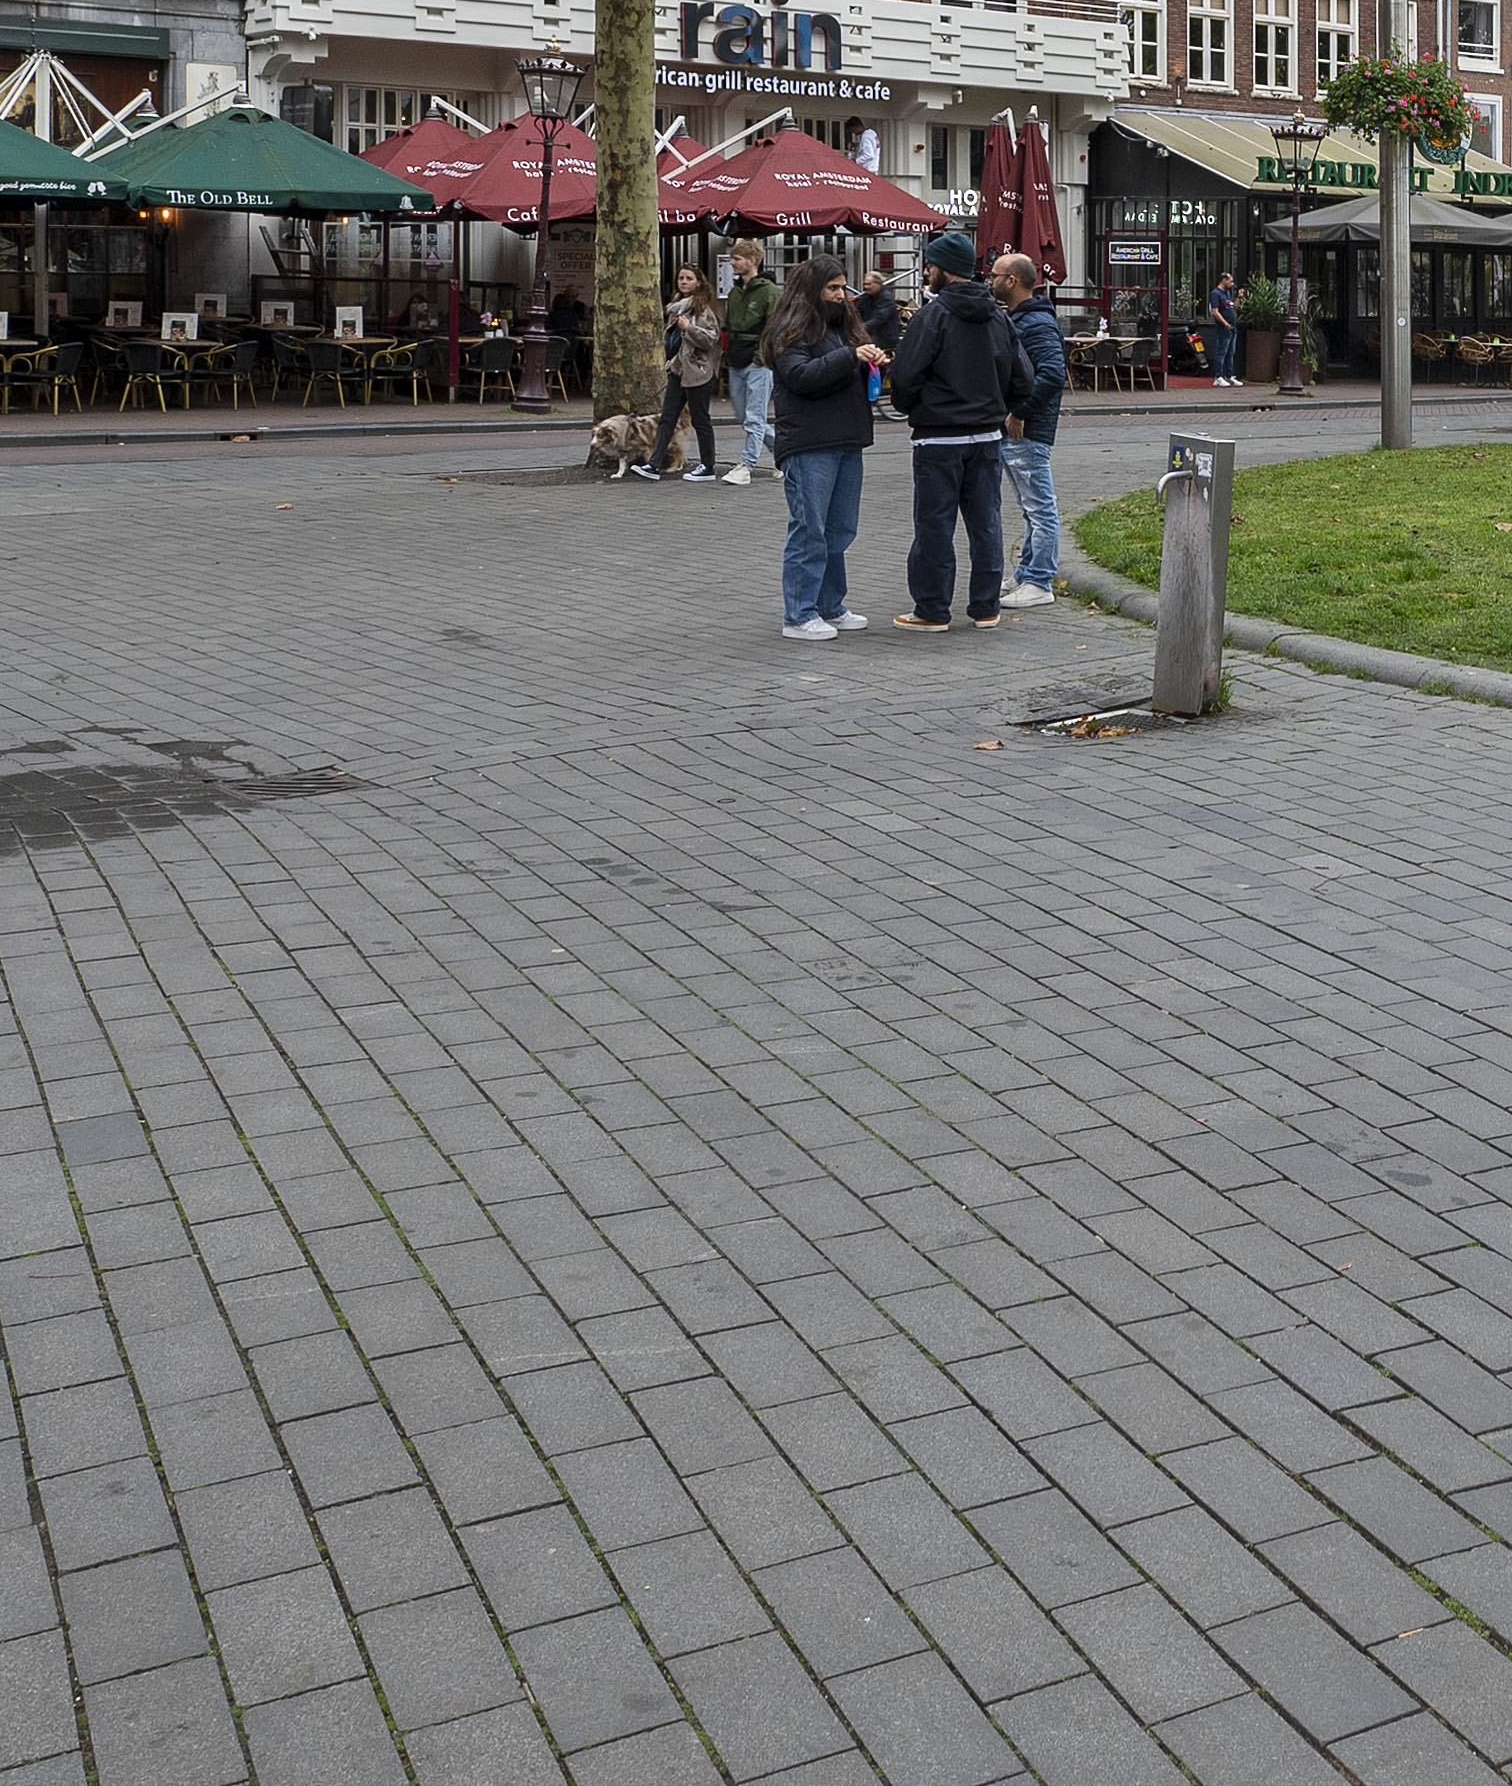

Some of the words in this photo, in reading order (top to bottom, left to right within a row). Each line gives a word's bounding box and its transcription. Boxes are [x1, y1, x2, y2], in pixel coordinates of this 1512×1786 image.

[655, 66, 700, 88] rican
[706, 70, 741, 94] grill
[746, 74, 836, 97] restaurant
[839, 80, 852, 98] &
[855, 81, 891, 101] cafe
[774, 173, 810, 181] ROYAL
[508, 206, 538, 221] Caf
[775, 211, 812, 226] Grill
[862, 212, 934, 232] Restaurant
